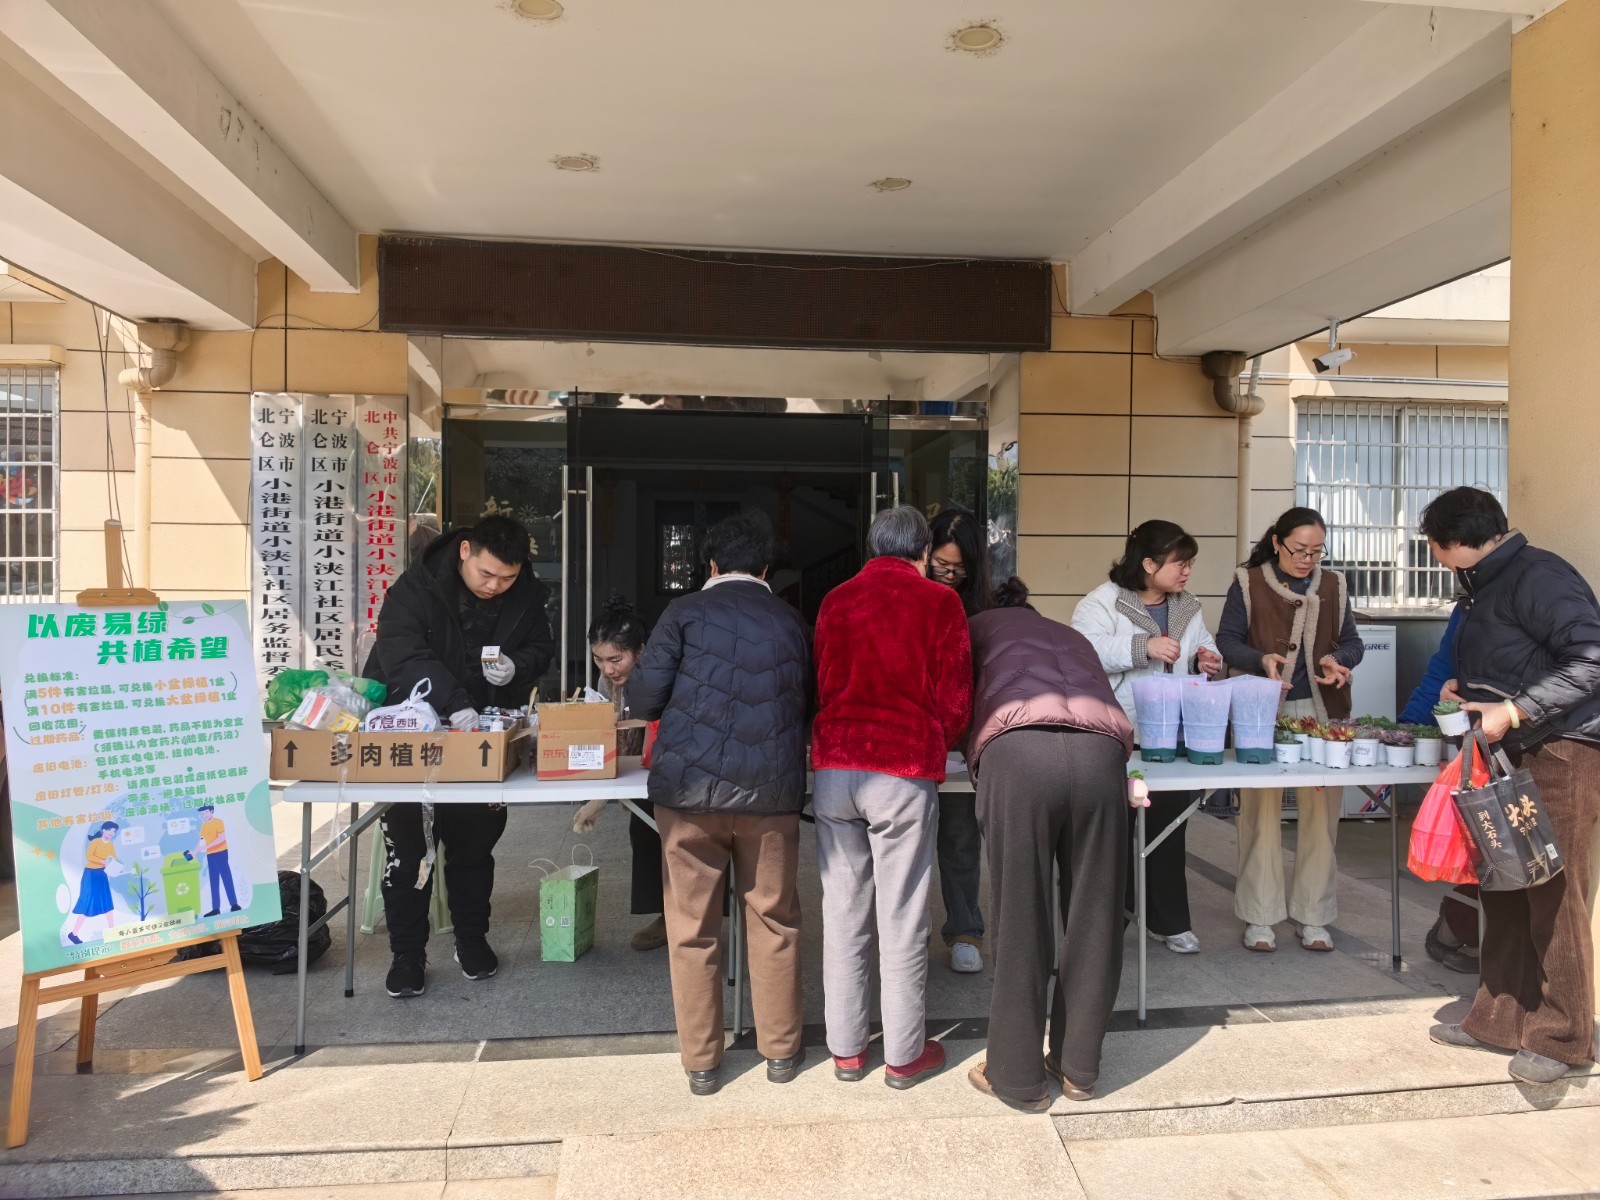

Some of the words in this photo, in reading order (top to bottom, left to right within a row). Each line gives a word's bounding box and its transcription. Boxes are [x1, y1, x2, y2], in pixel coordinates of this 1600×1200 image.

[258, 408, 275, 472] 北仑区
[279, 408, 295, 473] 宁波市
[311, 409, 328, 472] 北仑区
[331, 409, 348, 473] 宁波市
[364, 410, 380, 484] 北仑区
[383, 410, 398, 485] 中共宁波市
[261, 478, 293, 690] 小港街道小浃江社区居务监督委
[27, 611, 168, 639] 以废易绿
[97, 636, 229, 665] 共植希望
[1364, 643, 1390, 651] GREE
[330, 742, 443, 767] 多肉植物
[1477, 809, 1502, 850] 到大石头
